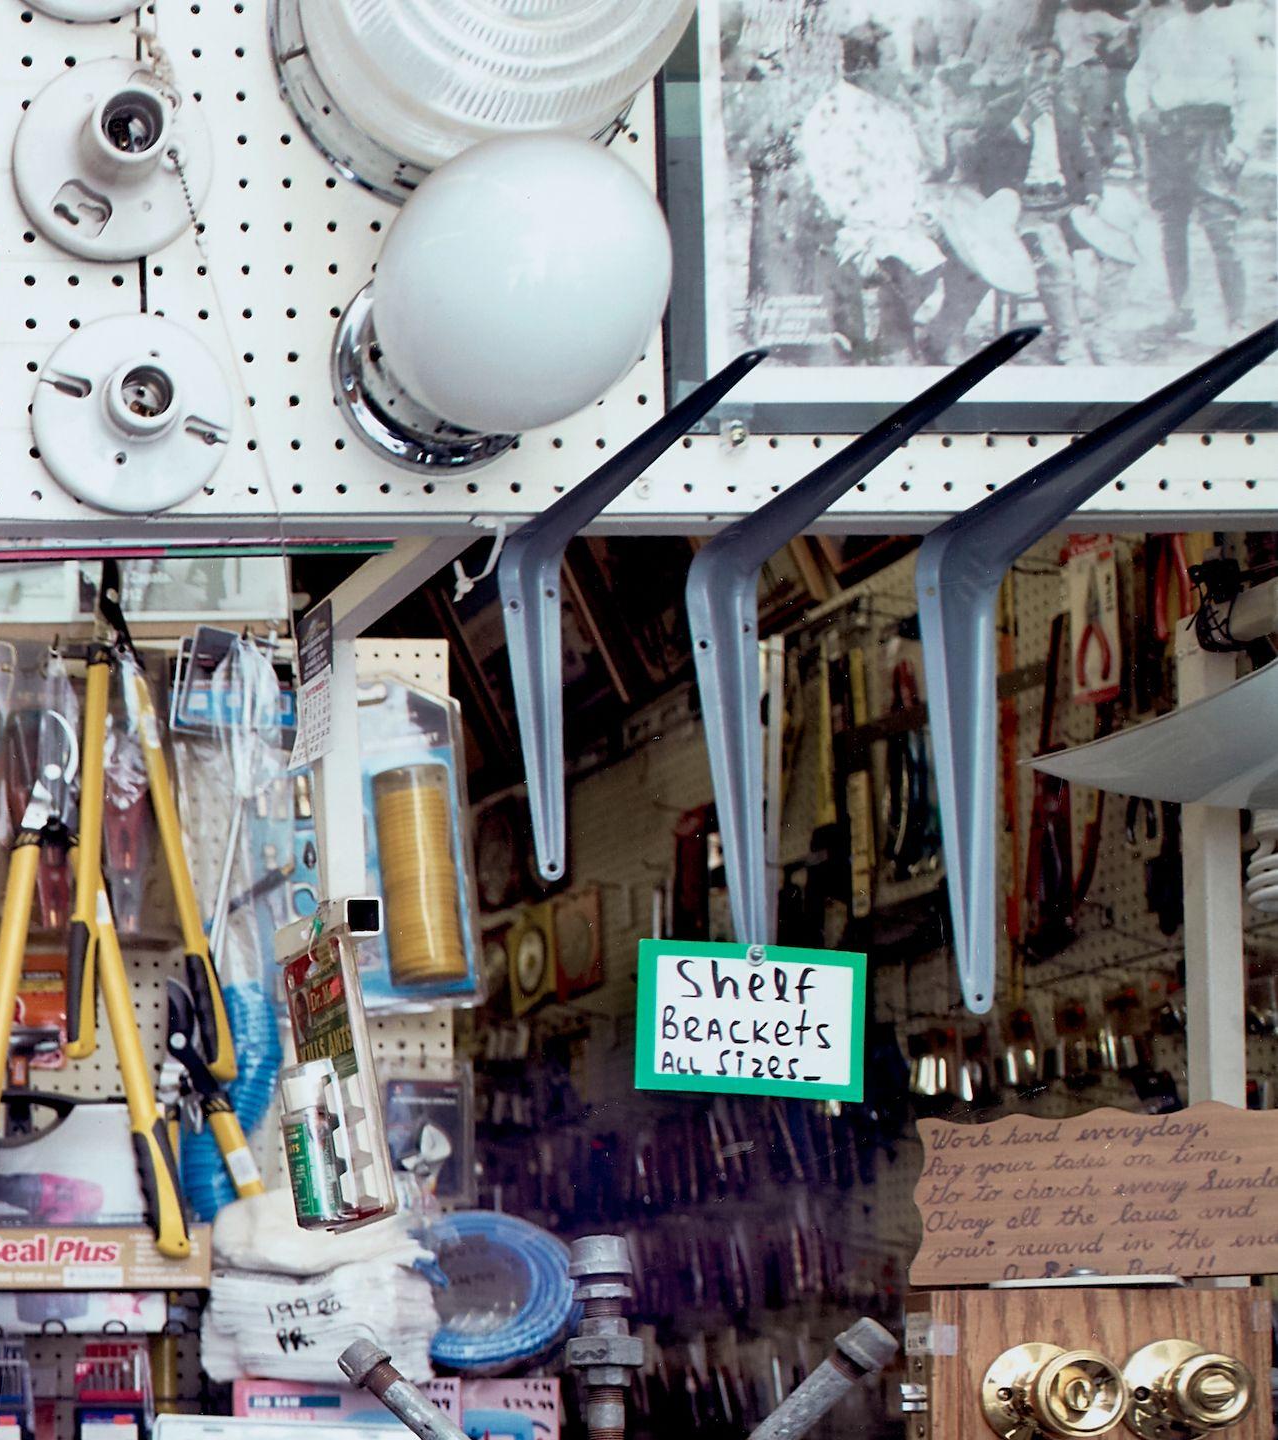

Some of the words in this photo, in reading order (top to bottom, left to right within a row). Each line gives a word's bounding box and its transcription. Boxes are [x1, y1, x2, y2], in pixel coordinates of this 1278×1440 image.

[676, 958, 817, 1004] Shelf
[328, 1023, 354, 1060] ANTS
[660, 1051, 703, 1075] ALL
[931, 1128, 993, 1151] Work
[1000, 1123, 1061, 1147] hard
[972, 1159, 1036, 1181] your
[1122, 1153, 1155, 1168] on
[969, 1180, 1000, 1203] to
[1013, 1177, 1102, 1201] church
[1113, 1179, 1189, 1203] every
[1006, 1205, 1041, 1230] all
[1054, 1205, 1098, 1228] the
[1109, 1202, 1183, 1226] laws
[1197, 1197, 1259, 1220] and
[53, 1239, 119, 1263] Plus
[1007, 1234, 1104, 1257] reward
[1118, 1232, 1156, 1253] in
[1166, 1228, 1216, 1252] the
